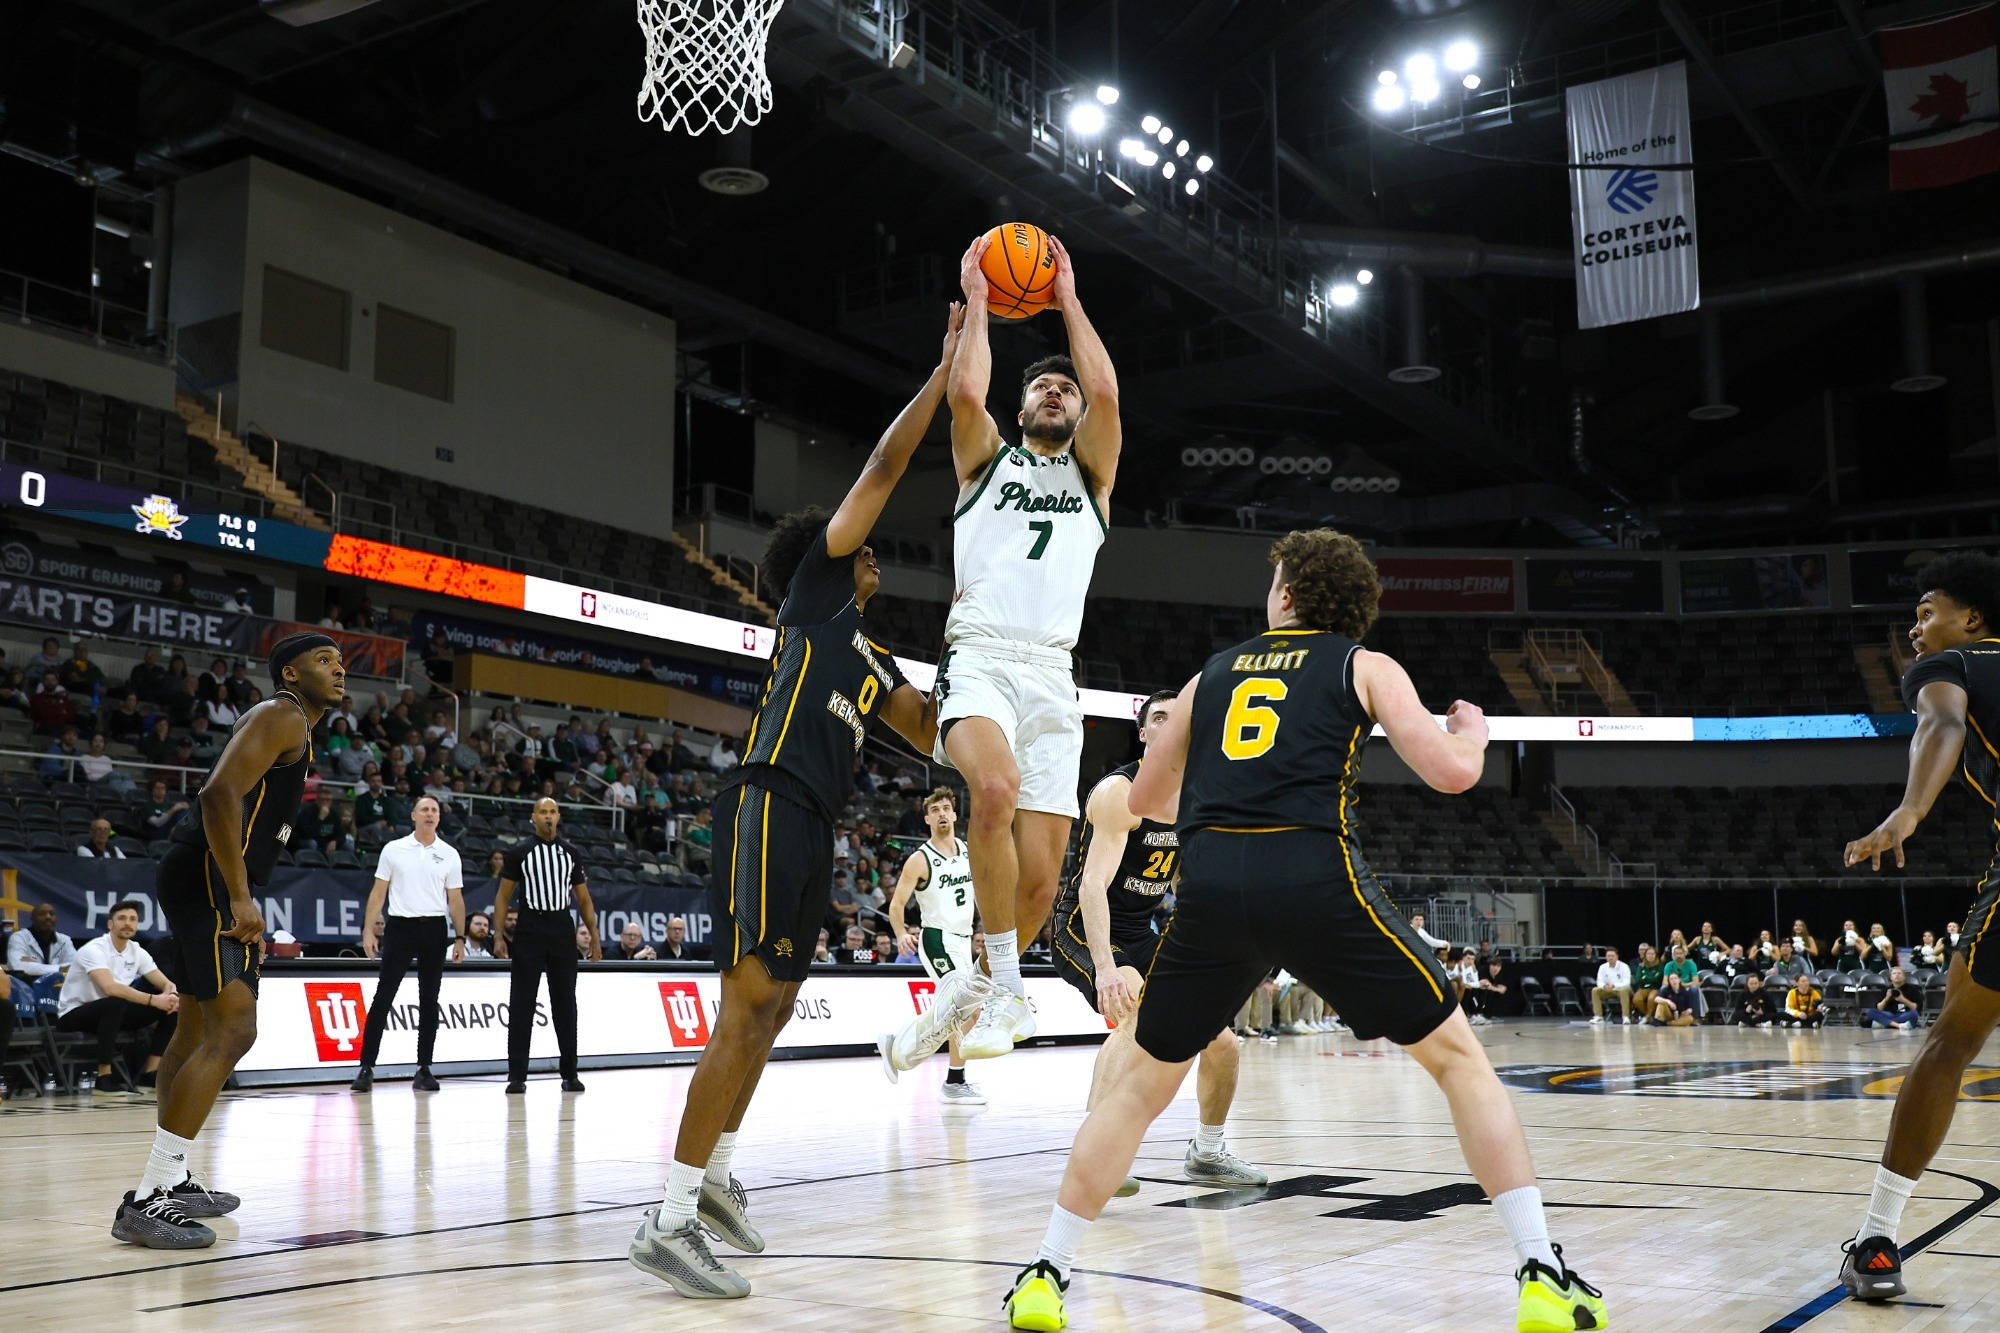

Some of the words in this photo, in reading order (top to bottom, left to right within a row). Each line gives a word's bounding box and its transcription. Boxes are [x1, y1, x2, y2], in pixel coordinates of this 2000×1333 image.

[1584, 146, 1628, 164] Home
[1632, 139, 1648, 156] of
[1651, 134, 1677, 149] the
[1584, 215, 1687, 247] CORTEVA
[1581, 232, 1692, 266] COLISEUM
[20, 471, 46, 507] 0
[994, 481, 1083, 513] Phoenix
[218, 513, 242, 530] FLS
[247, 520, 257, 533] 0
[218, 532, 243, 549] TOL
[246, 538, 255, 551] 4
[1026, 520, 1053, 560] 7
[40, 558, 88, 579] SPORT
[92, 567, 163, 593] GRAPHICS
[133, 603, 233, 647] HERE.
[477, 634, 502, 652] som
[527, 642, 545, 655] th
[1231, 649, 1309, 672] ELLIOTT
[858, 674, 878, 715] 0
[1221, 677, 1288, 760] 6
[1596, 724, 1644, 732] INDIANAPOLIS
[1142, 831, 1180, 846] NORTHE
[1143, 850, 1175, 878] 24
[938, 873, 972, 890] Phoeni
[954, 888, 966, 907] 2
[853, 949, 873, 960] POSS
